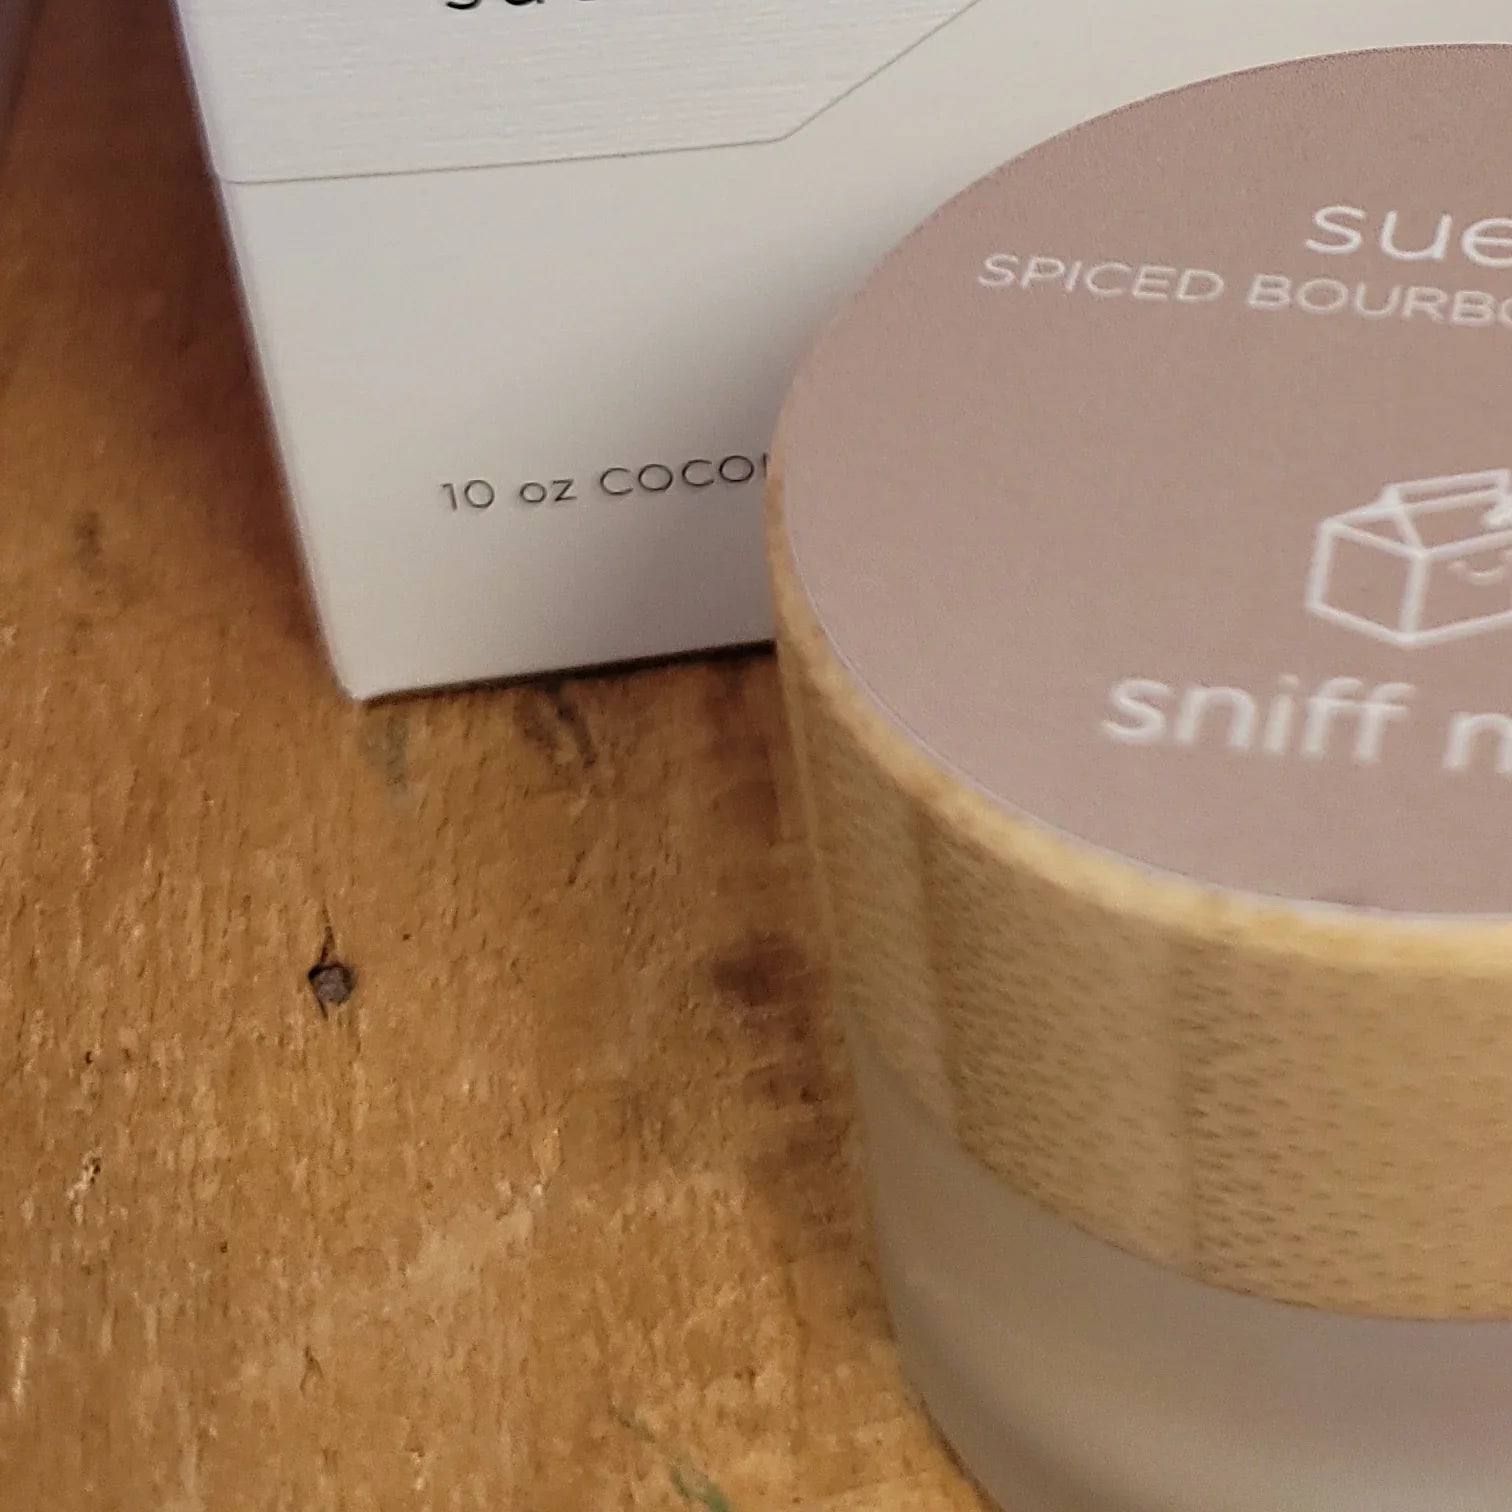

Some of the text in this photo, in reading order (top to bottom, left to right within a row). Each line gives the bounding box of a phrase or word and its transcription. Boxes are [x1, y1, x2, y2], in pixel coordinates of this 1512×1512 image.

[977, 252, 1226, 304] SPICED
[441, 479, 495, 511] 10
[518, 478, 577, 504] oz
[1103, 675, 1416, 764] sniff
